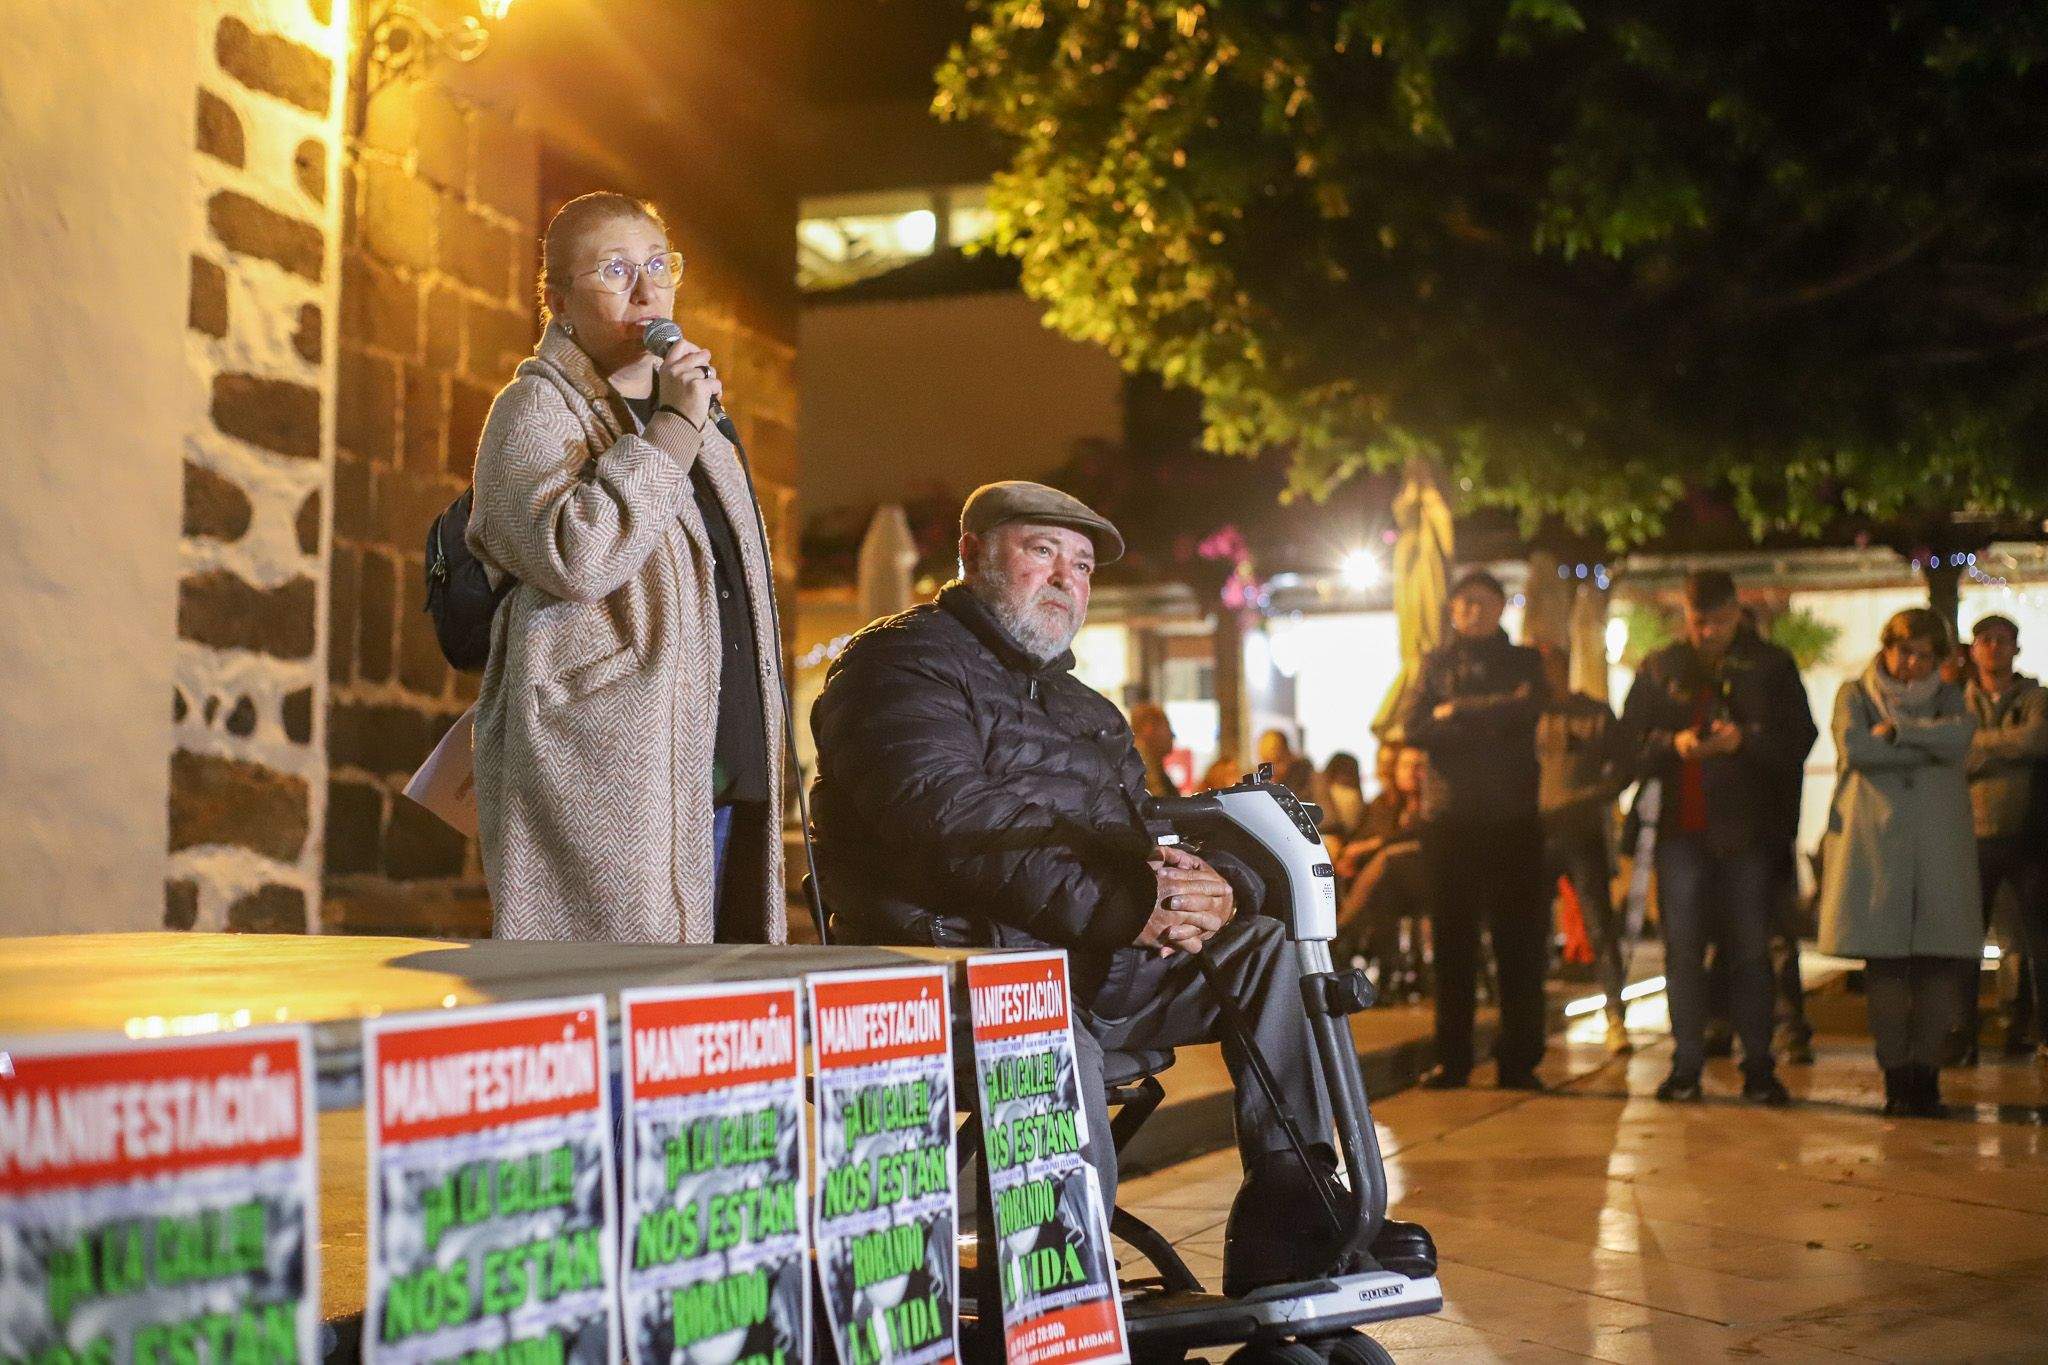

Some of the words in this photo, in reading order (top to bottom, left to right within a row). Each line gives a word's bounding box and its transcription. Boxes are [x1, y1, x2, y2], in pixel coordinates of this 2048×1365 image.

[634, 1002, 793, 1085] MANIFESTACIÓN
[820, 986, 942, 1056] MANIFESTACIÓN
[382, 1023, 595, 1128] MANIFESTACIÓN
[1001, 1058, 1015, 1102] LA
[1013, 1103, 1080, 1165] ESTÁN
[824, 1160, 872, 1221] NOS
[877, 1138, 948, 1206] ESTÁN
[997, 1177, 1056, 1240] ROBANDO
[635, 1200, 700, 1271] NOS
[852, 1220, 924, 1289] ROBANDO
[382, 1256, 473, 1345] NOS
[1359, 1284, 1404, 1301] QUEST
[1065, 1338, 1078, 1354] DE
[1078, 1330, 1116, 1351] ARIDANE
